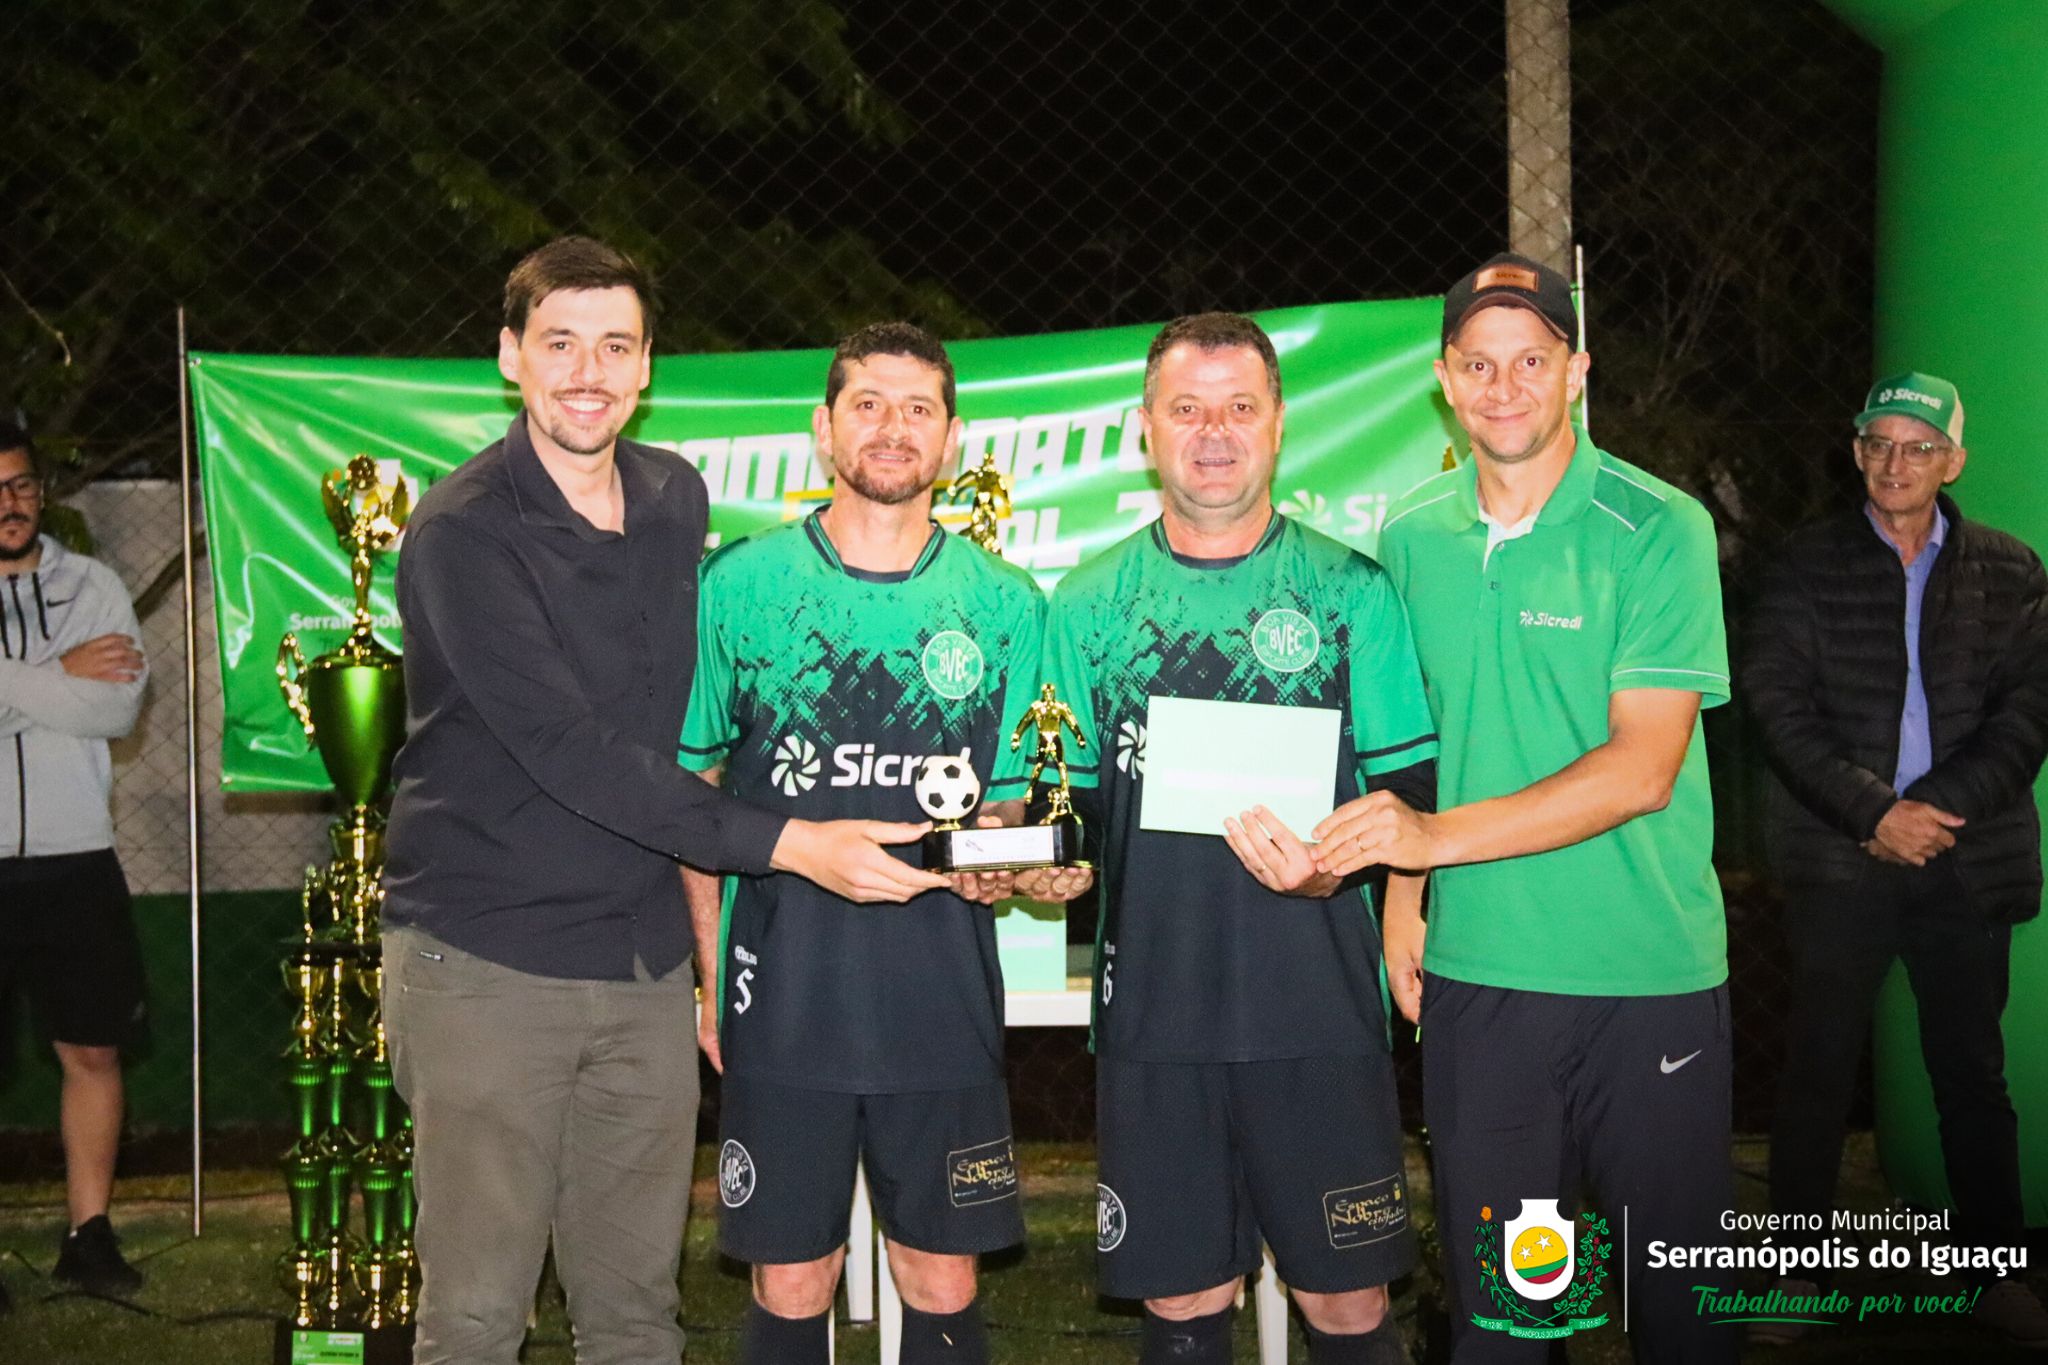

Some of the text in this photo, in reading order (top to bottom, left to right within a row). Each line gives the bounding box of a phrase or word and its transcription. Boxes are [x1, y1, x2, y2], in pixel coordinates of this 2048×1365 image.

[1893, 388, 1943, 410] Sicredi
[1533, 612, 1583, 630] Sicredi
[1269, 623, 1302, 656] BVEC
[939, 647, 969, 682] BVEC
[831, 744, 971, 787] Sicr
